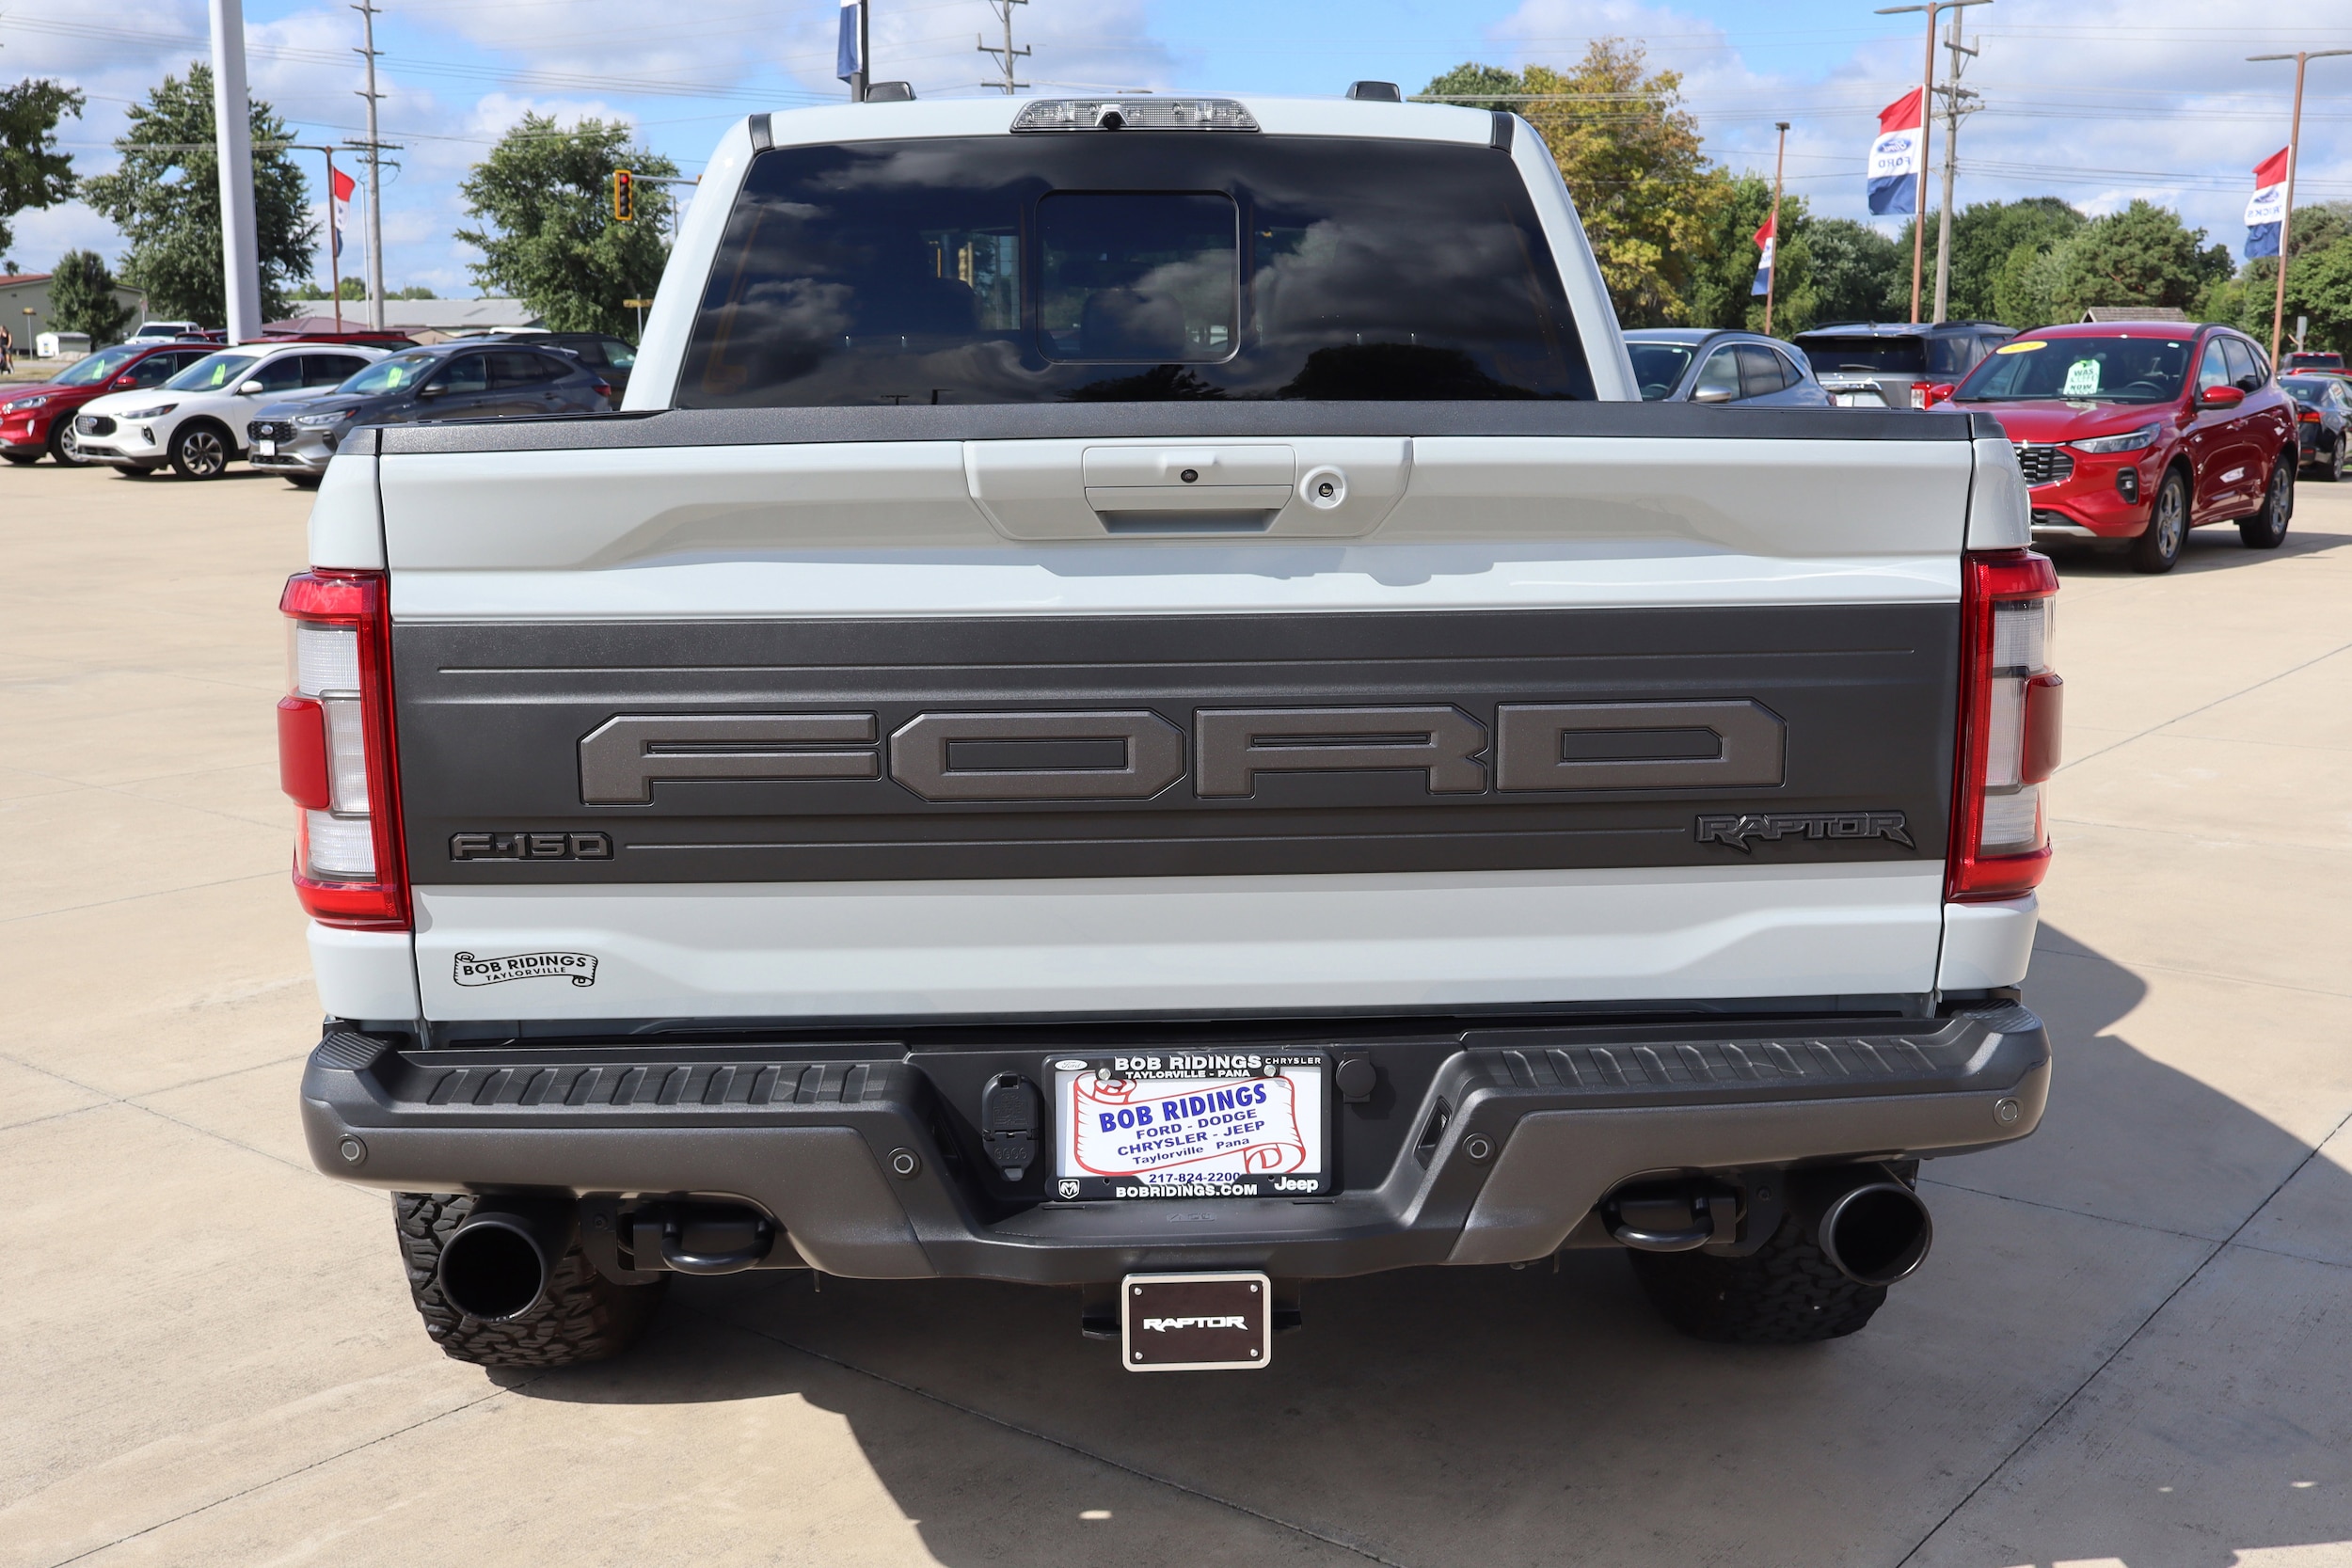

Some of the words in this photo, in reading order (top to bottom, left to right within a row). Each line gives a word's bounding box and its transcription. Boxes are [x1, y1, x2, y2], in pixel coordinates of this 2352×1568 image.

[577, 697, 1788, 807] FORD
[1695, 811, 1917, 855] RAPTOR
[449, 832, 614, 861] F-150
[463, 961, 502, 975] BOB
[507, 955, 587, 971] RIDINGS
[485, 966, 567, 981] TAYLORVILLE
[1114, 1055, 1162, 1070] BOB
[1168, 1053, 1263, 1070] RIDINGS
[1264, 1056, 1322, 1065] CHRYSLER
[1125, 1070, 1207, 1079] TAYLORVILLE
[1217, 1069, 1251, 1078] PANA
[1099, 1105, 1153, 1133] BOB
[1161, 1083, 1267, 1122] RIDINGS
[1136, 1123, 1183, 1140] FORD
[1198, 1108, 1258, 1129] DODGE
[1117, 1132, 1208, 1156] CHRYSLER
[1223, 1120, 1265, 1137] JEEP
[1132, 1146, 1204, 1164] Taylorville
[1216, 1137, 1250, 1149] Pana
[1149, 1172, 1240, 1183] 217-824-2200
[1274, 1176, 1319, 1193] Jeep
[1116, 1183, 1258, 1198] BOBRIDINGS.COM
[1143, 1316, 1249, 1333] RAPTOR
